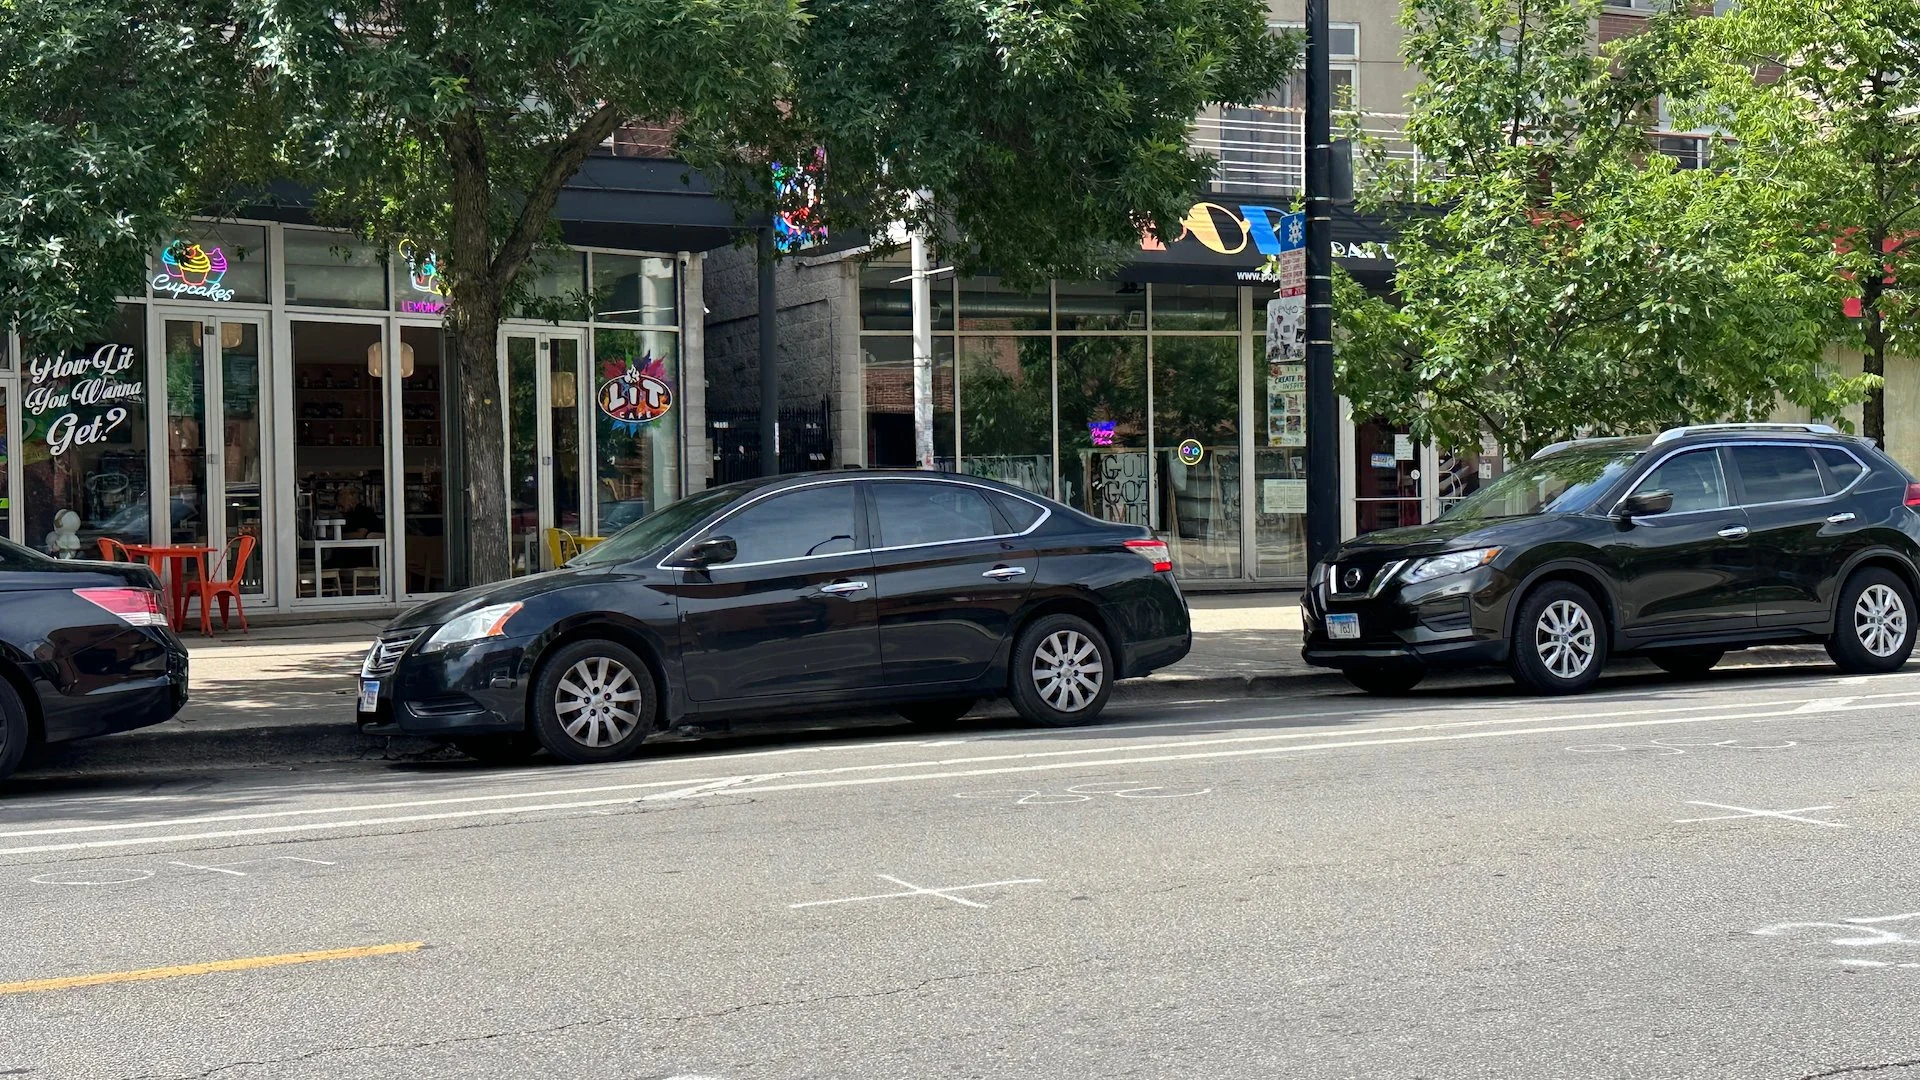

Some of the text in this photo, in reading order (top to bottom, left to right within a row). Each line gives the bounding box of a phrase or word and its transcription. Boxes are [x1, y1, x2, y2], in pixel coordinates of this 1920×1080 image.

[152, 273, 235, 301] Cupcakes
[30, 344, 134, 384] How Lit
[24, 377, 142, 415] You Wanna
[46, 407, 127, 456] Get?
